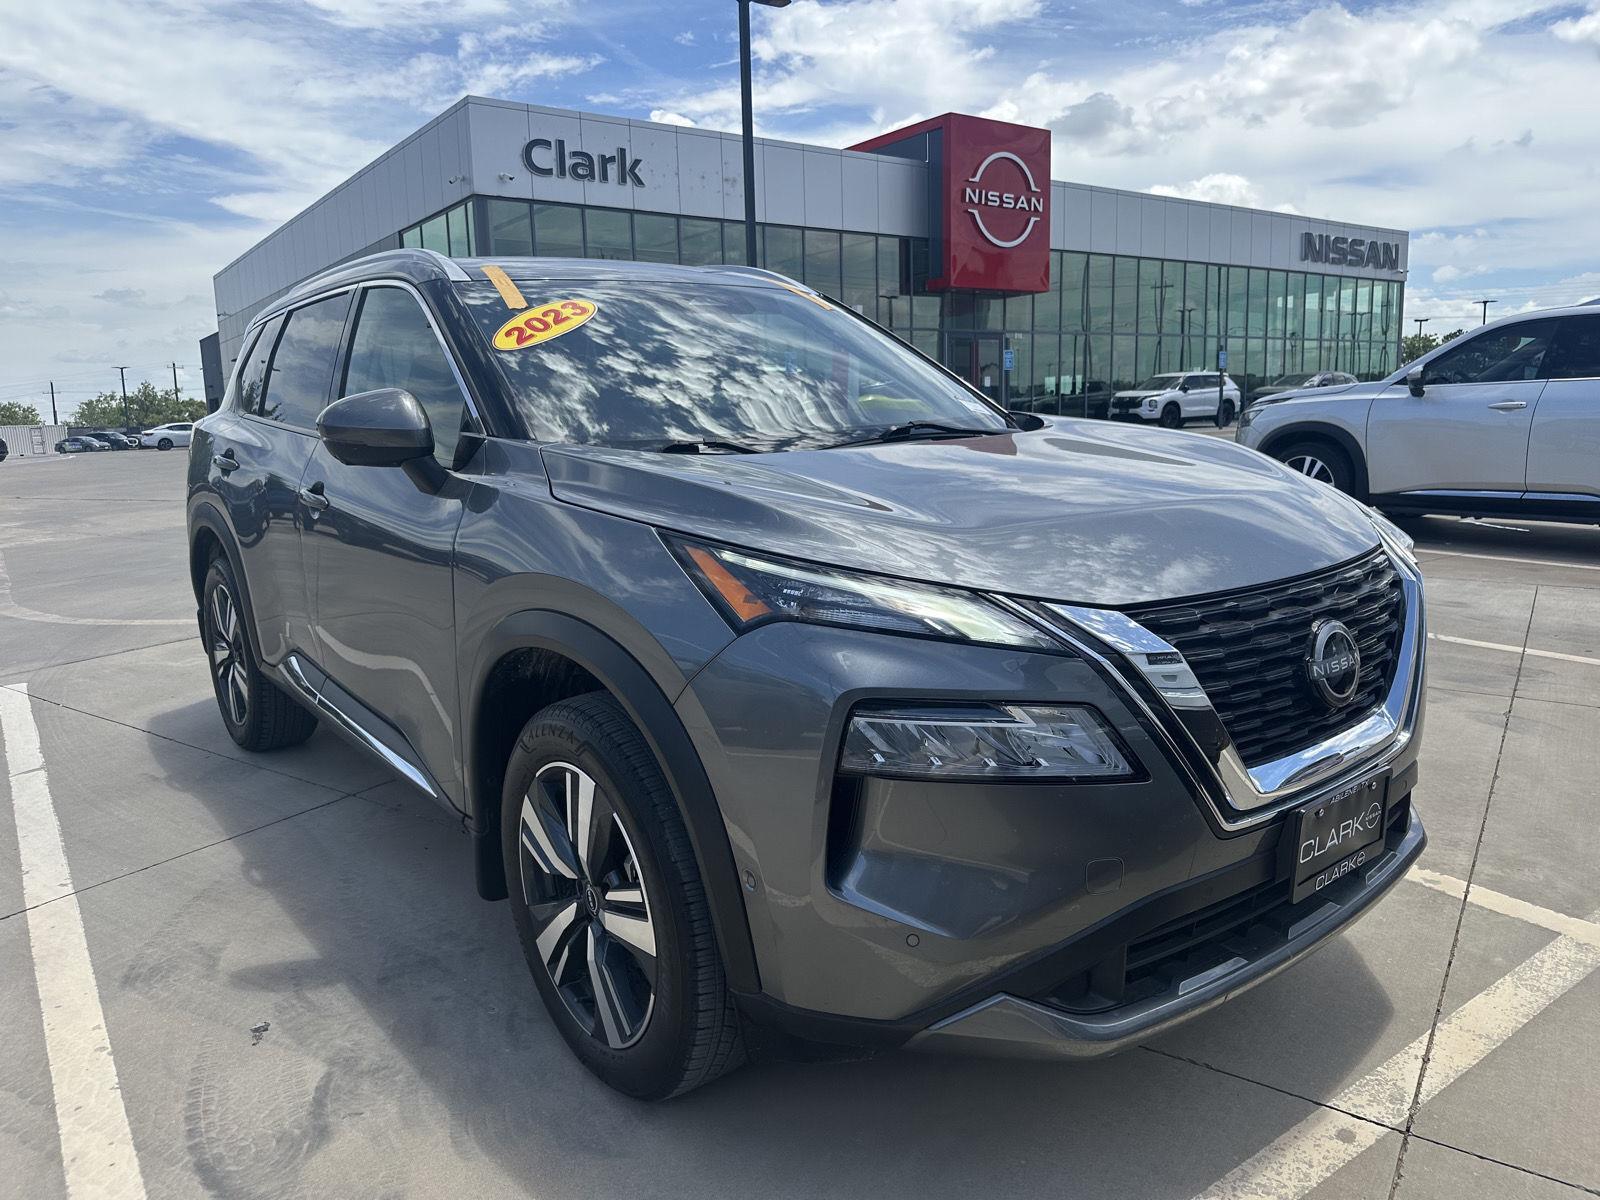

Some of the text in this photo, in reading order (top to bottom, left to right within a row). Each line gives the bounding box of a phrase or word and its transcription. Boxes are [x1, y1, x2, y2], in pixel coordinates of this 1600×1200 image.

[522, 138, 646, 188] Clark
[964, 187, 1044, 213] NISSAN
[1301, 232, 1400, 270] NISSAN
[504, 301, 590, 346] 2023
[1312, 652, 1361, 678] NISSAN
[1299, 811, 1364, 864] CLARK
[1315, 854, 1357, 891] CLARK
